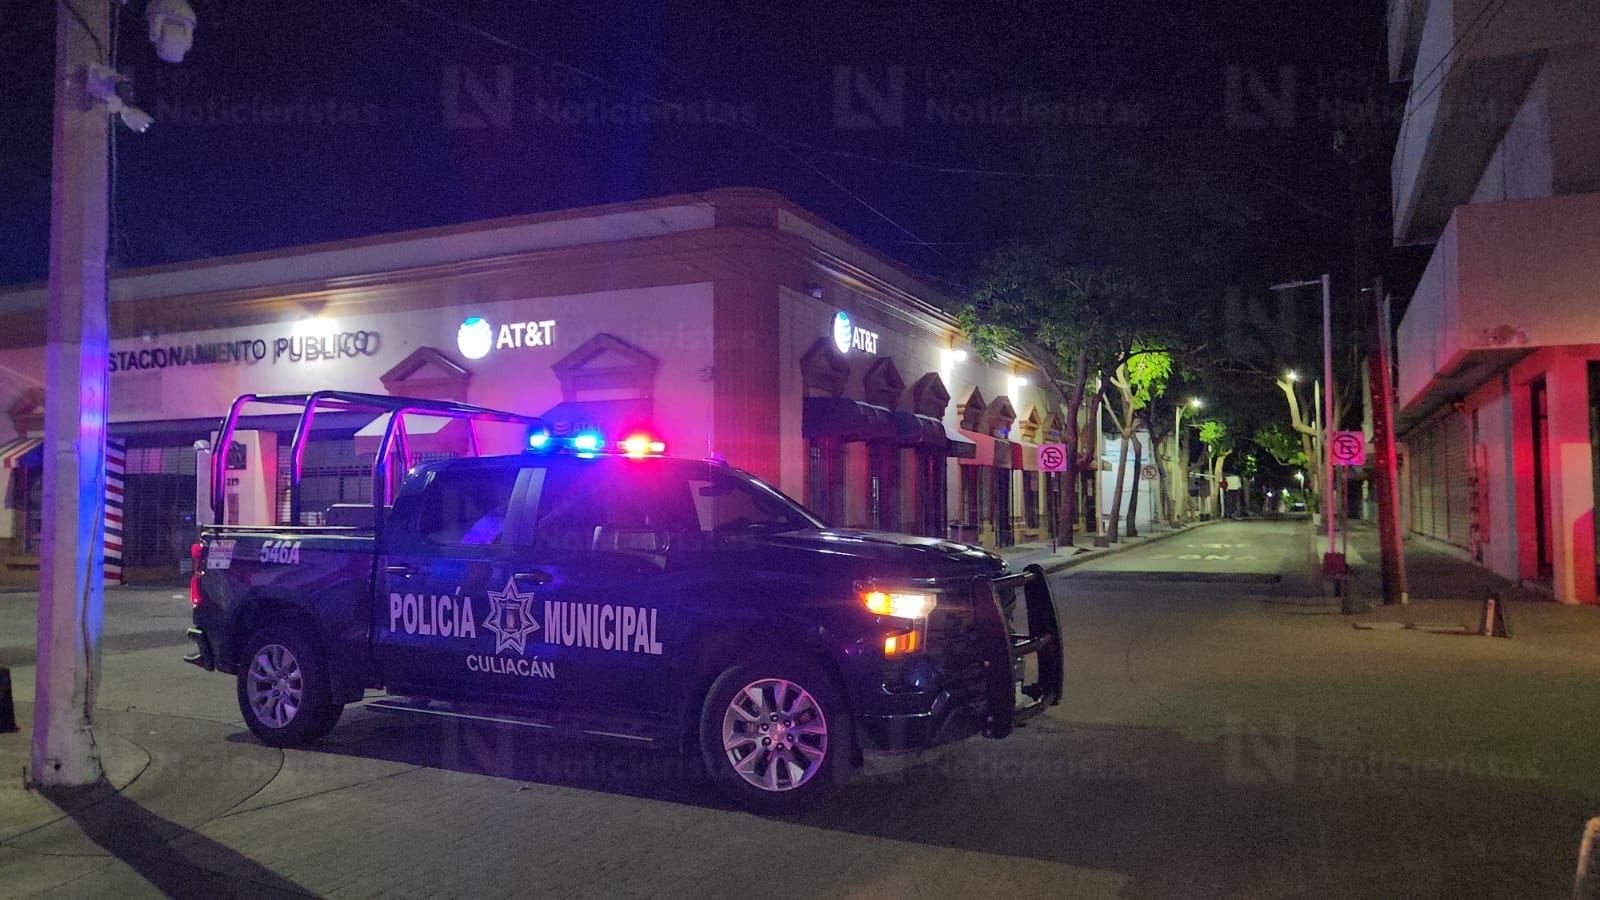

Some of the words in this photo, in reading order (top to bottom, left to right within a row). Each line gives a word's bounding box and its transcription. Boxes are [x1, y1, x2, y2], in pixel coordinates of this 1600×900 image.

[496, 319, 556, 349] AT&T
[852, 326, 879, 354] AT&T
[109, 338, 266, 372] STACIONAMIENTO
[260, 540, 302, 564] 546A
[390, 586, 477, 639] POLICÍA
[544, 600, 663, 655] MUNICIPAL
[466, 654, 556, 680] CULIACÁN
